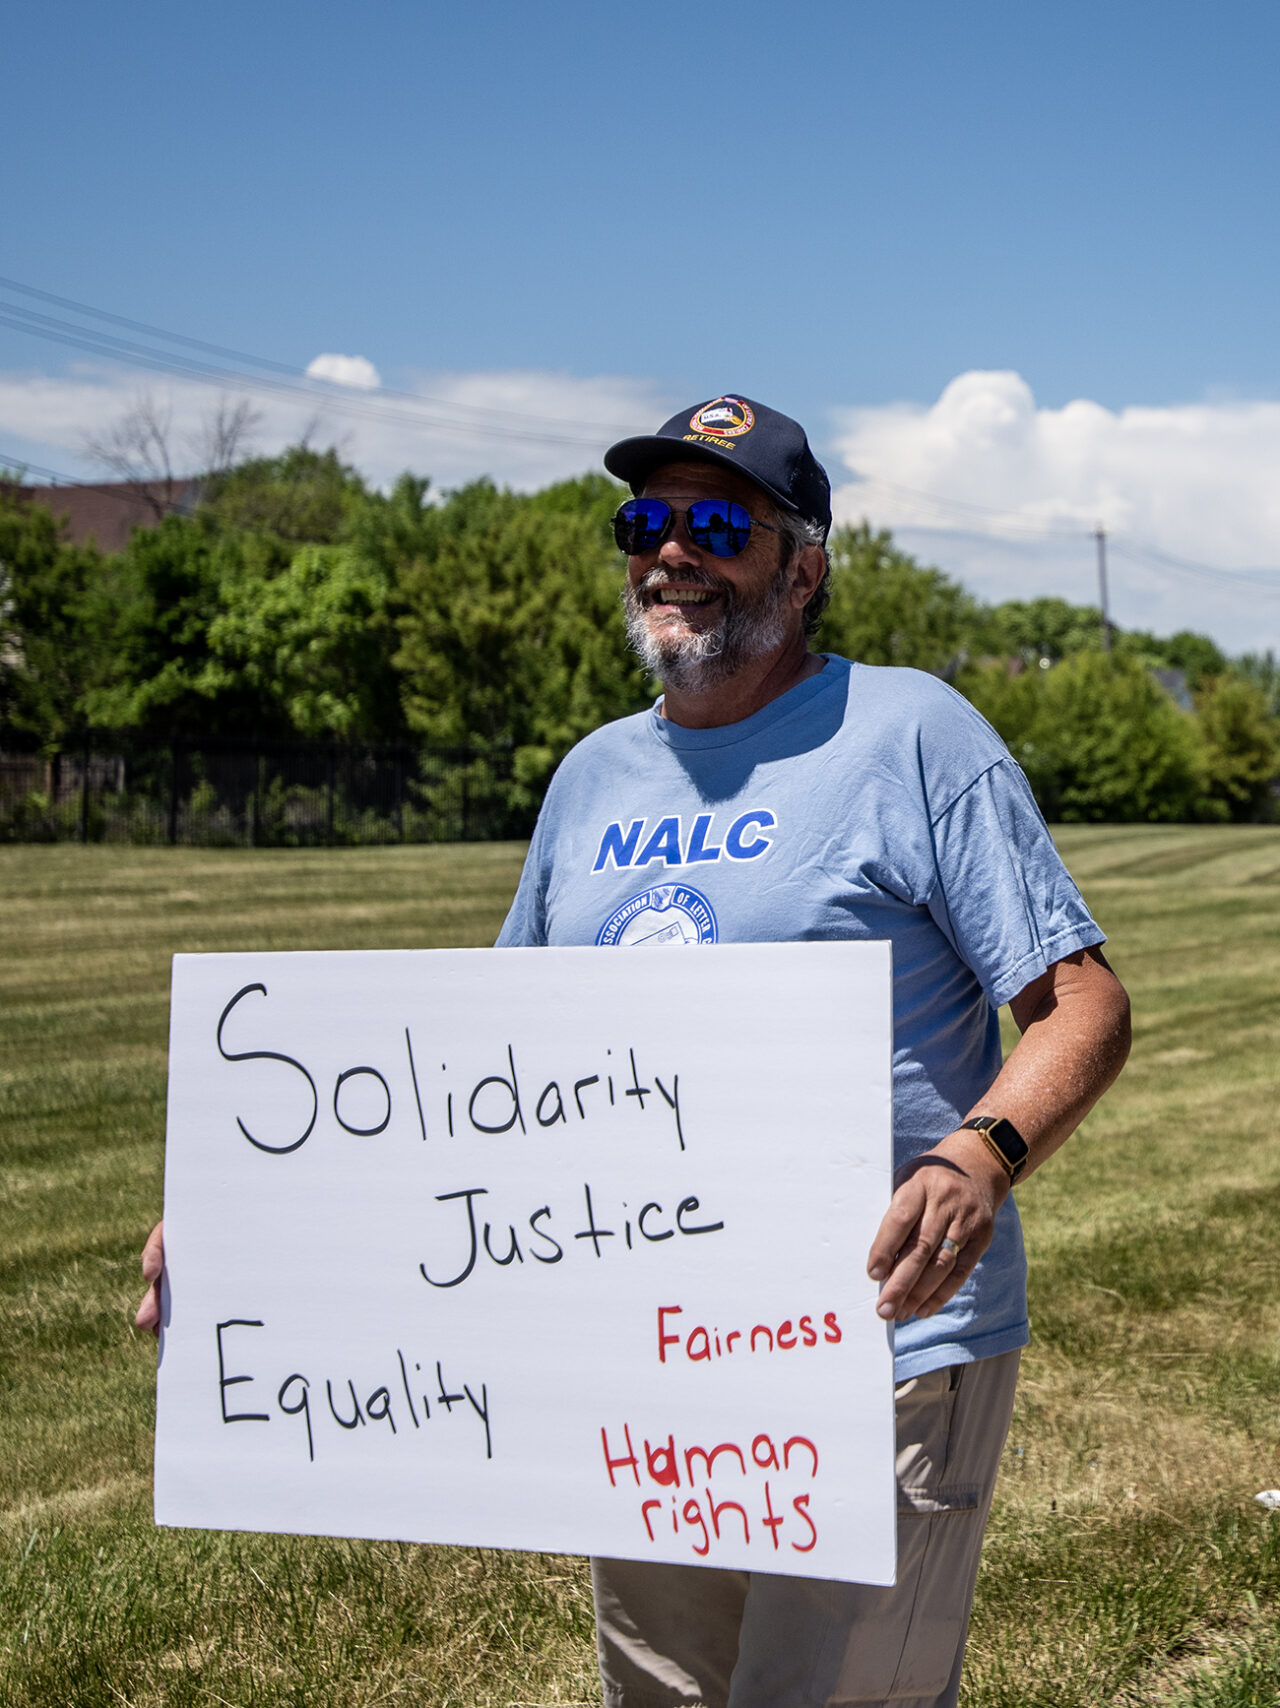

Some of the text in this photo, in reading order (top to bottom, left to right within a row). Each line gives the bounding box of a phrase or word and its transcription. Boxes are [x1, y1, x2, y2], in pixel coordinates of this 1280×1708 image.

[682, 434, 736, 450] RETIREE
[590, 808, 777, 875] NALC
[602, 892, 712, 945] SSOCIATION OF LETTER
[216, 983, 685, 1155] Solidarity
[420, 1184, 725, 1288] Justice
[657, 1305, 843, 1363] Fairness
[216, 1320, 493, 1462] Equality
[600, 1423, 819, 1488] Human
[641, 1482, 818, 1556] rights
